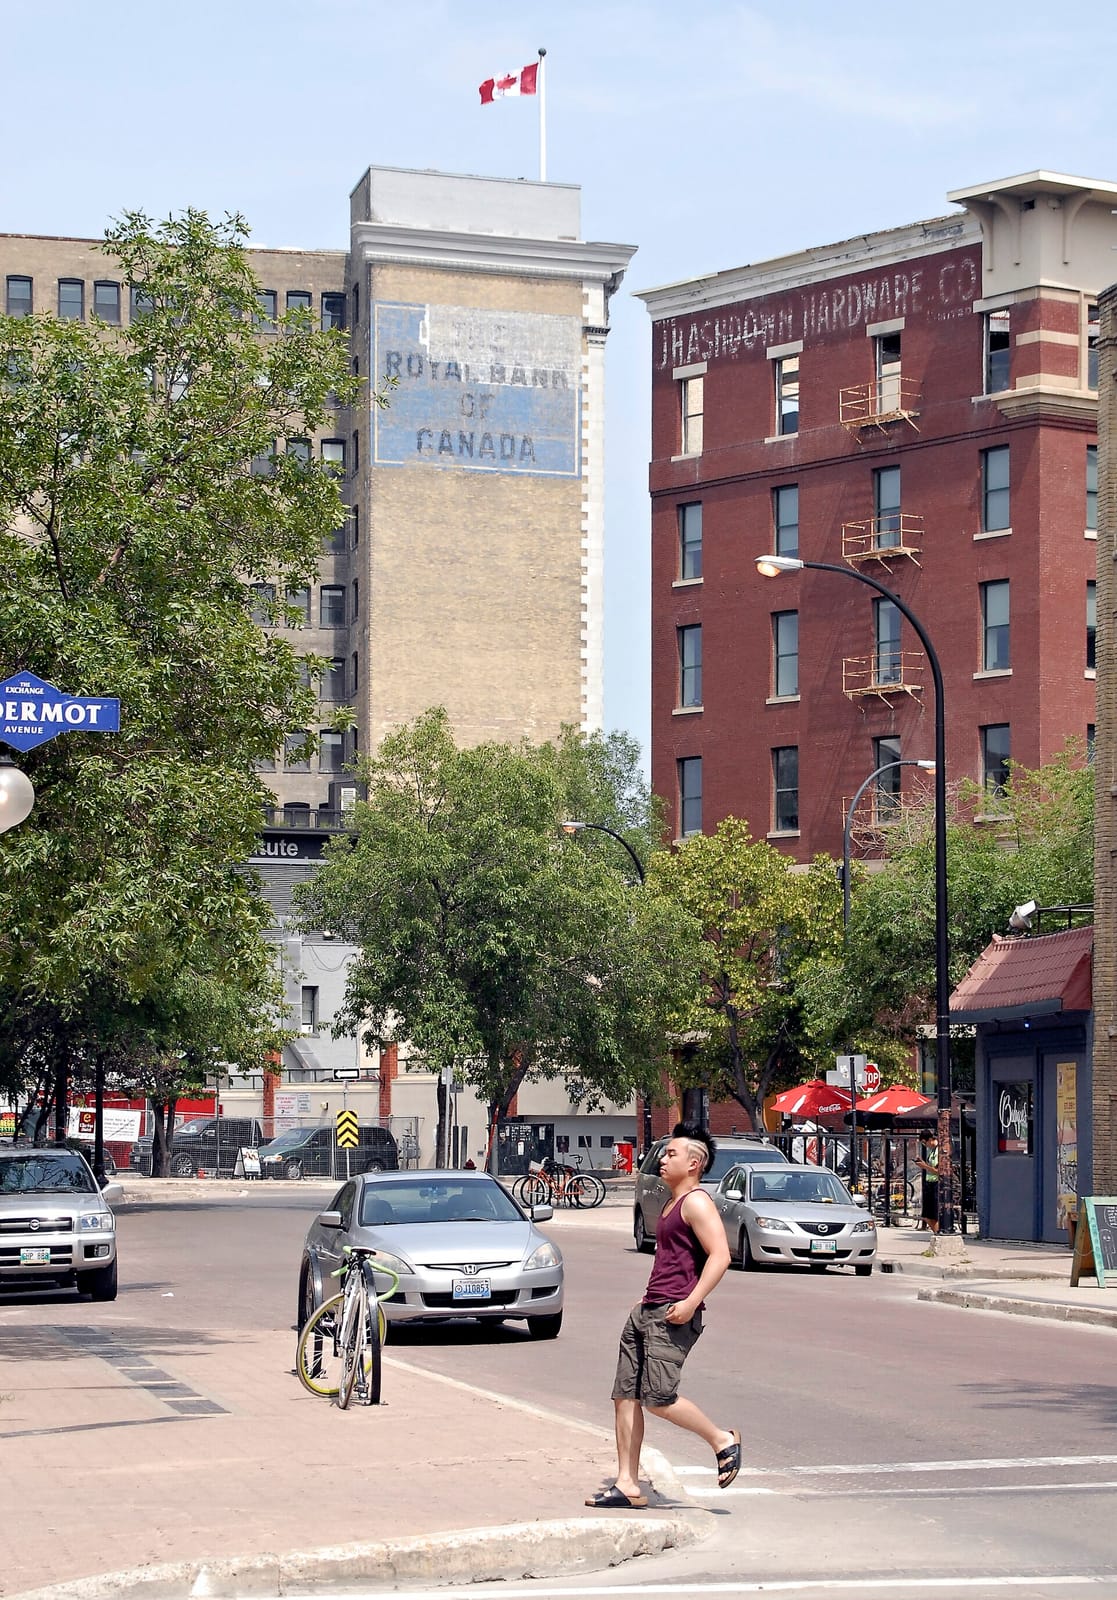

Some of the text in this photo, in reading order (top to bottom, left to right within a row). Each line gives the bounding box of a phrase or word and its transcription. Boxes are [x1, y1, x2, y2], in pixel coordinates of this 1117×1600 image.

[416, 427, 536, 463] CANADA
[5, 686, 44, 694] EXCHANGE
[0, 701, 101, 724] ERMOT
[4, 725, 44, 734] AVENUE
